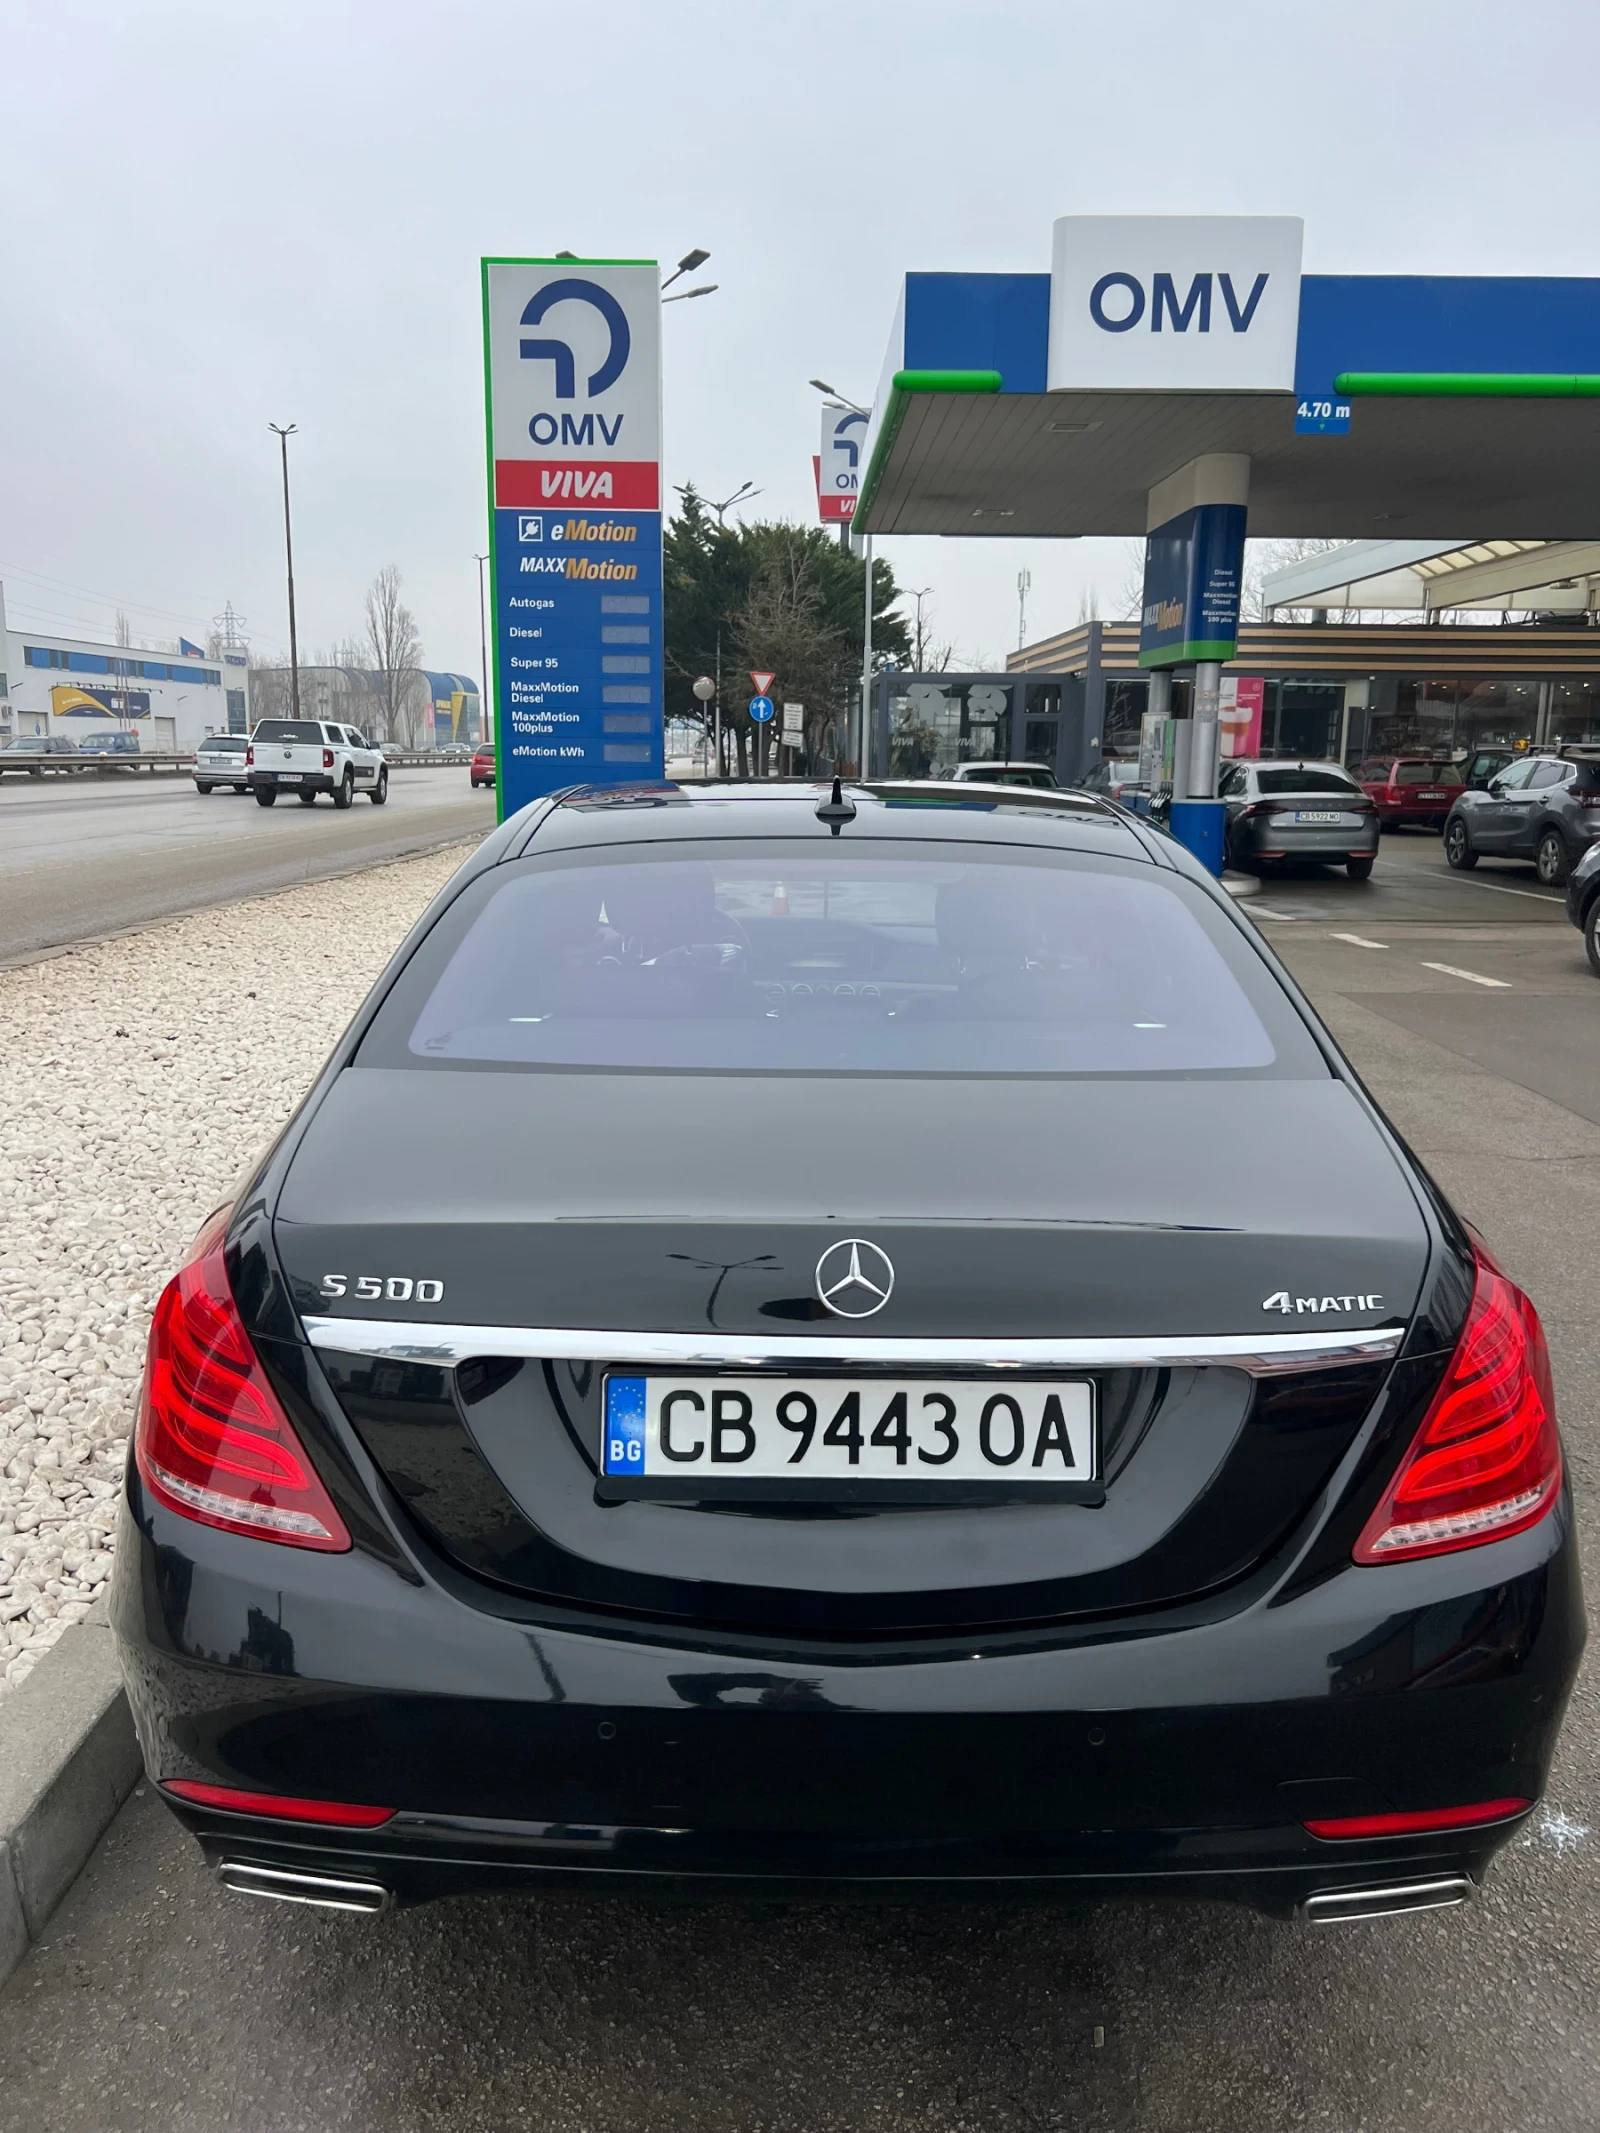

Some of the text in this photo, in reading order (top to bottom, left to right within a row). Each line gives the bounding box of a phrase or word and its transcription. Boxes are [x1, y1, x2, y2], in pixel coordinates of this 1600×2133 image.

[1089, 271, 1270, 333] OMV
[1297, 401, 1350, 418] 4.70 m
[528, 412, 624, 446] OMV
[541, 470, 613, 499] VIVA
[550, 518, 637, 541] eMotion
[519, 556, 638, 580] MAXXMotion
[1209, 580, 1227, 588] Super
[509, 596, 555, 610] Autogas
[1220, 616, 1233, 624] plus
[509, 626, 543, 638] Diesel
[510, 656, 559, 669] Super 95
[511, 681, 579, 693] MaxxMotion
[511, 692, 544, 703] Diesel
[511, 711, 580, 722] MaxxMotion
[512, 722, 554, 735] 100plus
[891, 736, 914, 747] VIVA
[954, 736, 977, 747] VIVA
[512, 745, 585, 757] eMotion kWh
[1300, 812, 1310, 820] CB
[1311, 812, 1329, 820] 5922
[319, 1274, 445, 1303] S 500
[1262, 1291, 1386, 1314] 4MATIC
[659, 1389, 757, 1464] CB
[775, 1390, 960, 1466] 9443
[609, 1440, 642, 1462] BG
